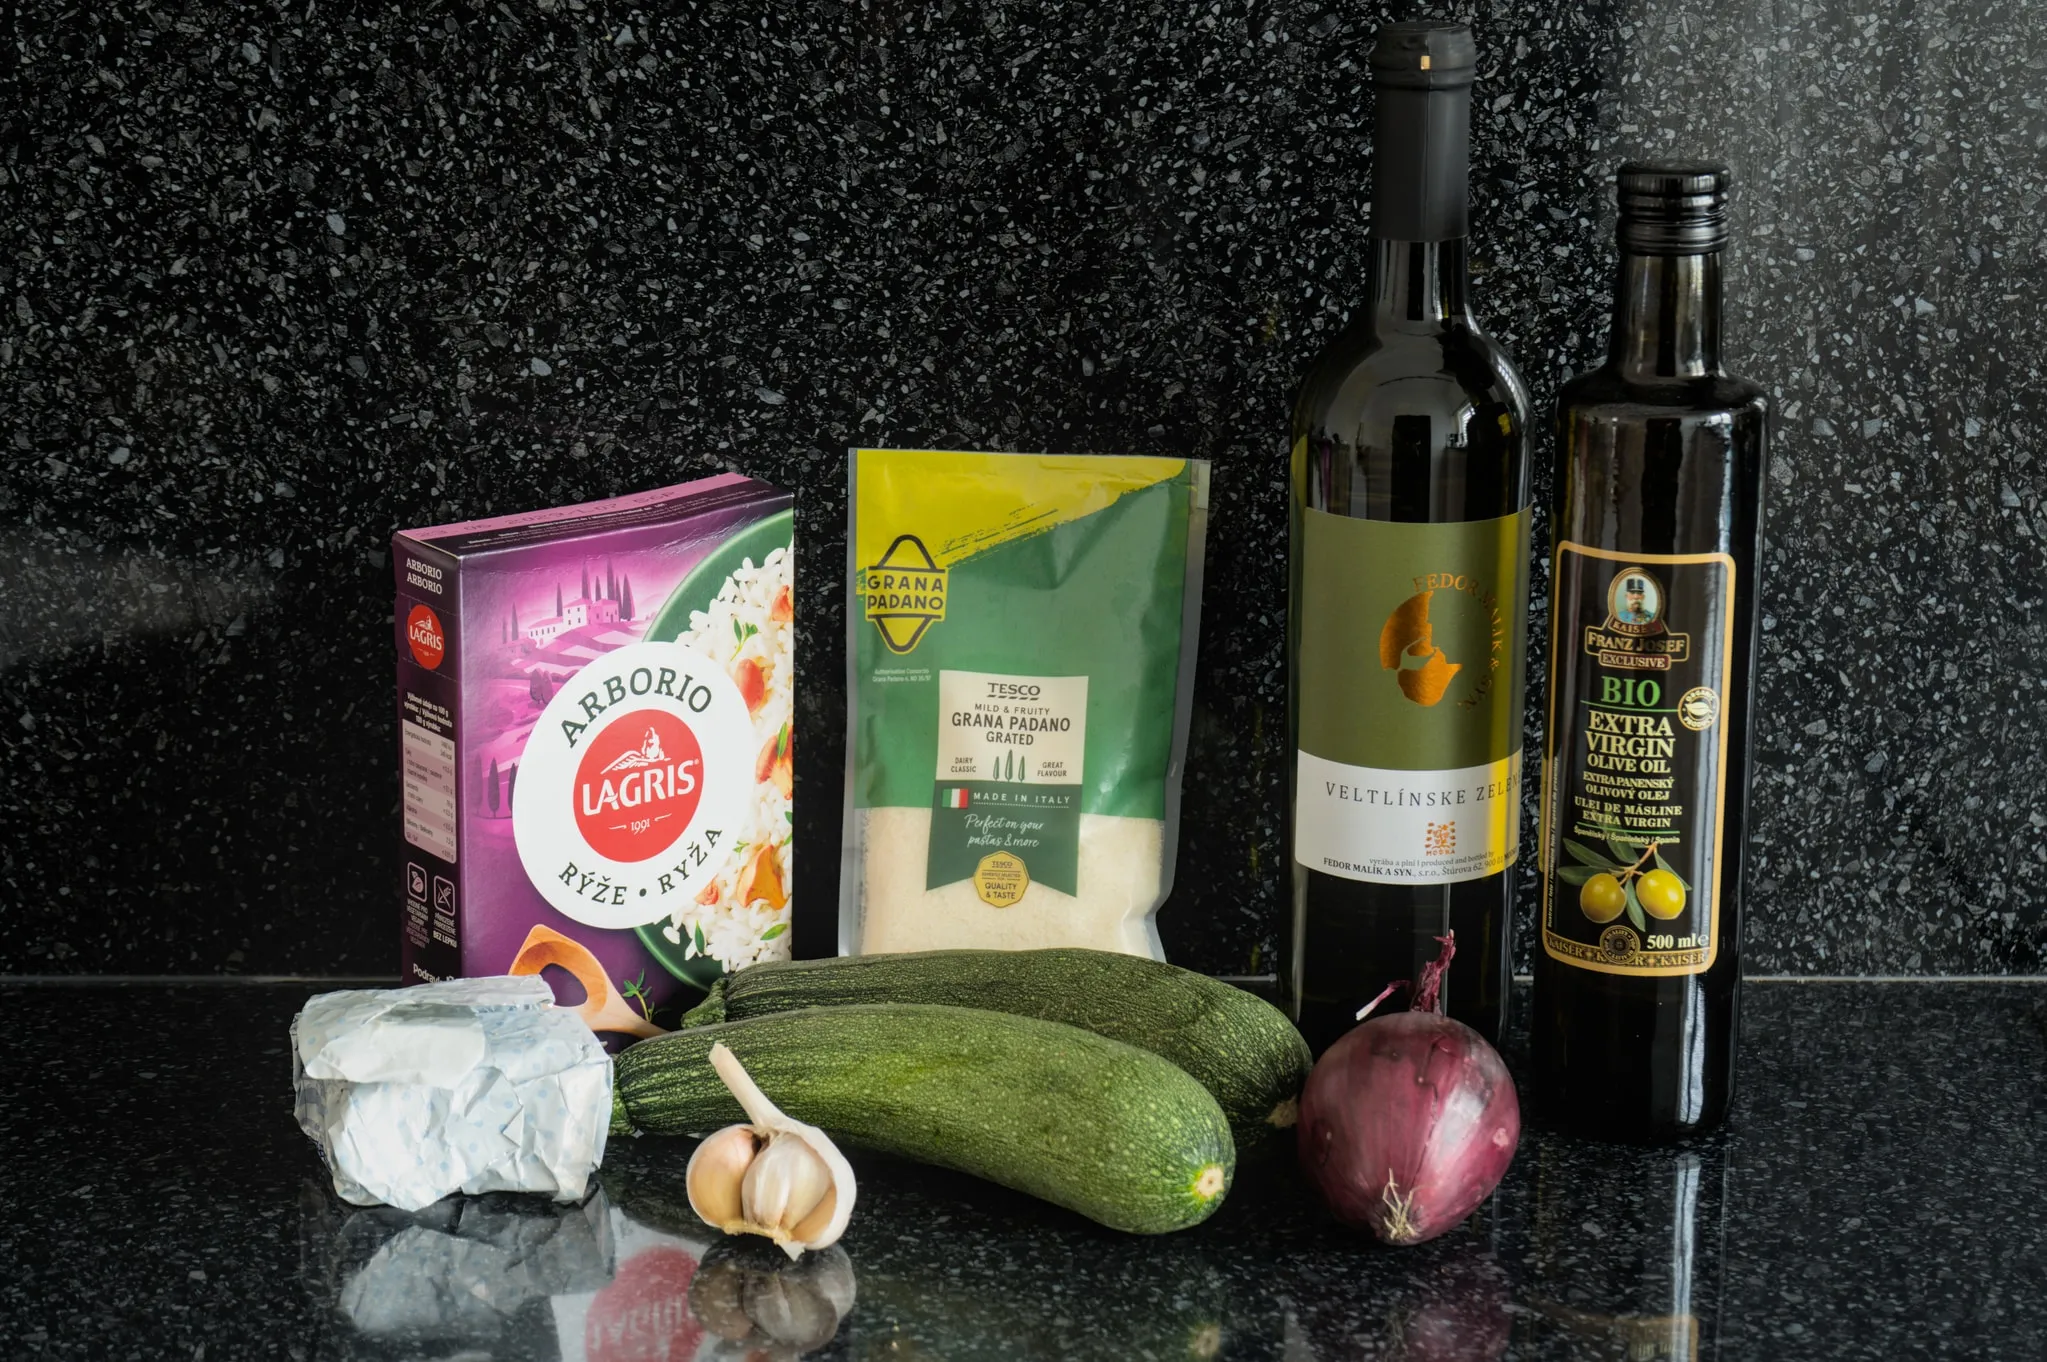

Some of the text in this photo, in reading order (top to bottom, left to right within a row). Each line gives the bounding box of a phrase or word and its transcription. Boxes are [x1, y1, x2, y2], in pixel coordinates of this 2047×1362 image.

[406, 558, 442, 580] ARBORIO
[407, 572, 443, 595] ARBORIO
[868, 575, 944, 593] GRANA
[1412, 573, 1479, 598] FEDOR
[867, 594, 944, 610] PADANO
[1612, 620, 1657, 634] KAISE
[409, 624, 442, 651] LAGRIS
[1588, 631, 1685, 653] FRANZ JOSEF
[1602, 653, 1666, 668] EXCLUSIVE
[987, 682, 1041, 696] TESCO
[1601, 675, 1661, 707] BIO
[560, 667, 712, 749] ARBORIO
[974, 703, 1050, 716] MILD & FRUITY
[952, 712, 1071, 732] GRANA PADANO
[1588, 710, 1674, 736] EXTRA
[986, 731, 1034, 746] GRATED
[1584, 730, 1676, 758] VIRGIN
[950, 765, 977, 773] CLASSIC
[1042, 761, 1064, 769] GREAT
[1587, 753, 1671, 773] OLIVE OIL
[582, 759, 695, 816] LAGRIS
[1326, 781, 1466, 806] VELTLÍNSKE
[1585, 784, 1670, 800] OLIVOVÝ OLEJ
[973, 792, 1070, 804] MADE IN ITALY
[1574, 796, 1601, 810] ULEI
[1604, 802, 1621, 813] DE
[630, 818, 651, 835] 1991
[964, 813, 1044, 835] Perfect on your
[1583, 811, 1672, 828] EXTRA VIRGIN
[967, 833, 1040, 848] pastas & more
[558, 827, 723, 906] RÝŽE RYŽA
[992, 860, 1013, 868] TESCO
[1323, 857, 1351, 870] FEDOR
[1353, 863, 1383, 875] MALÍK
[1442, 866, 1472, 875] Štúrova
[1421, 857, 1454, 867] produced
[1456, 855, 1467, 863] and
[985, 882, 1017, 890] QUALITY
[993, 891, 1016, 899] TASTE
[1550, 938, 1583, 957] KAISER
[1647, 935, 1674, 949] 500
[1678, 933, 1696, 947] ml
[1661, 954, 1705, 966] KAISER
[413, 963, 442, 983] Podrav
